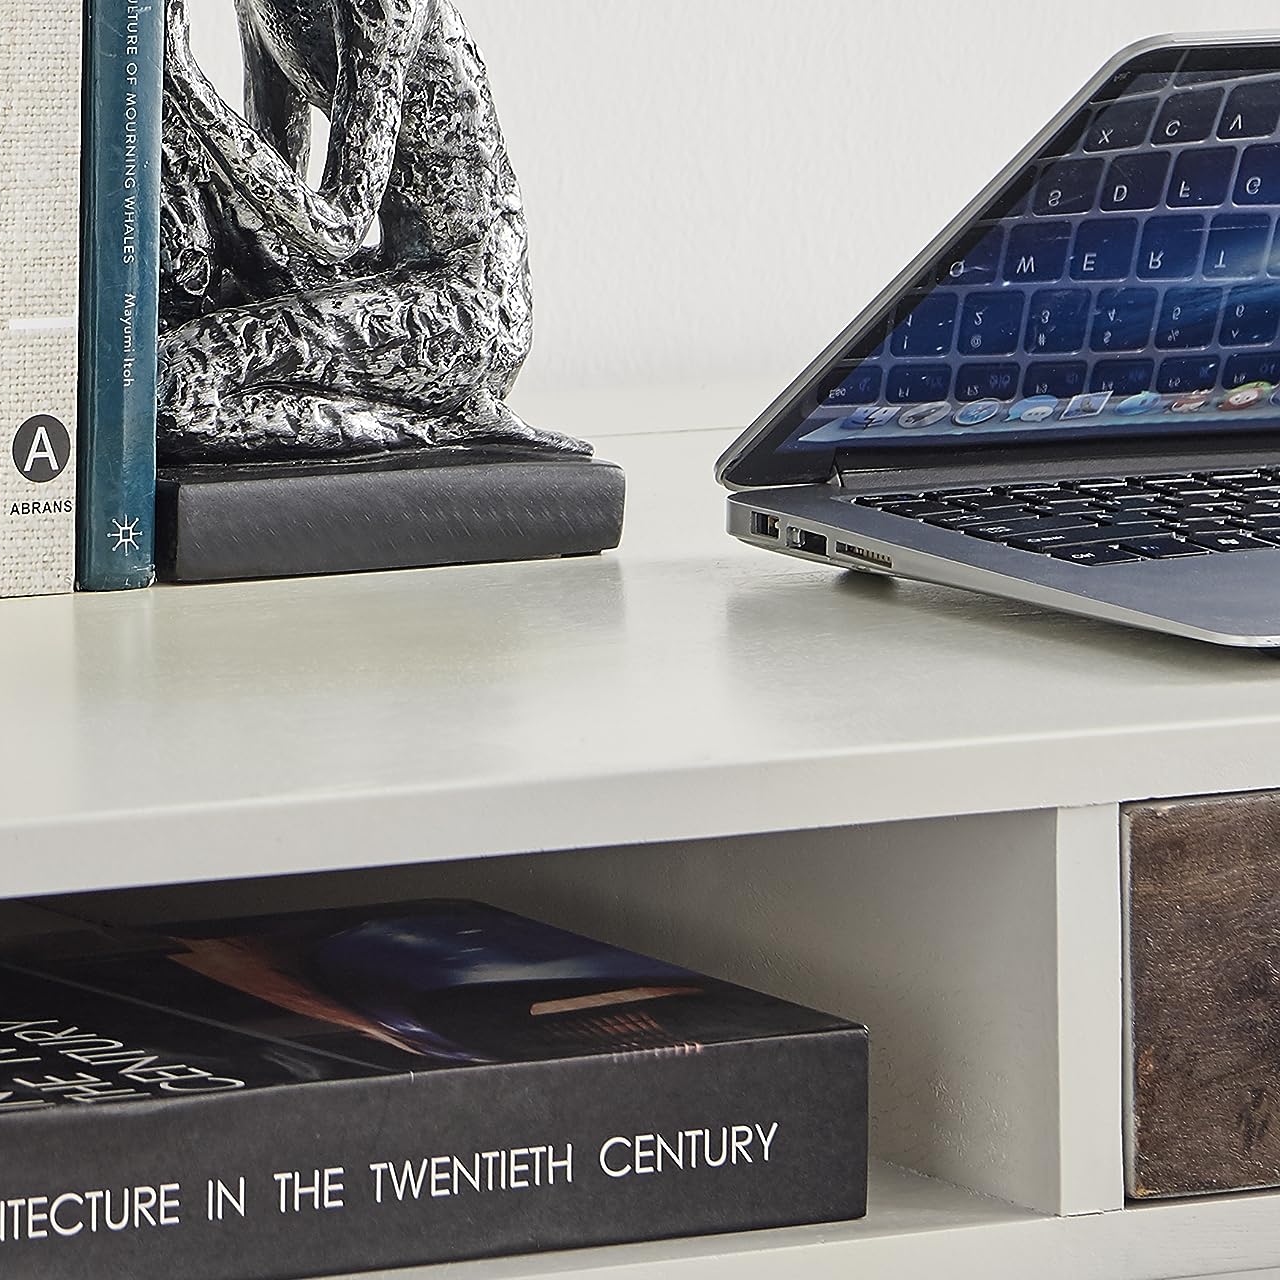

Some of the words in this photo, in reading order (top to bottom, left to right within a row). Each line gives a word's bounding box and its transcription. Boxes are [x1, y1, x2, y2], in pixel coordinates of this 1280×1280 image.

[125, 62, 138, 86] OF
[123, 92, 138, 190] MOURNING
[122, 195, 136, 265] WHALES
[119, 293, 137, 352] Mayumi
[122, 358, 136, 388] Itoh
[22, 425, 61, 473] A
[9, 499, 74, 517] ABRANS
[206, 1177, 247, 1223] IN
[273, 1166, 346, 1213] THE
[370, 1142, 574, 1202] TWENTIETH
[598, 1122, 781, 1178] CENTURY
